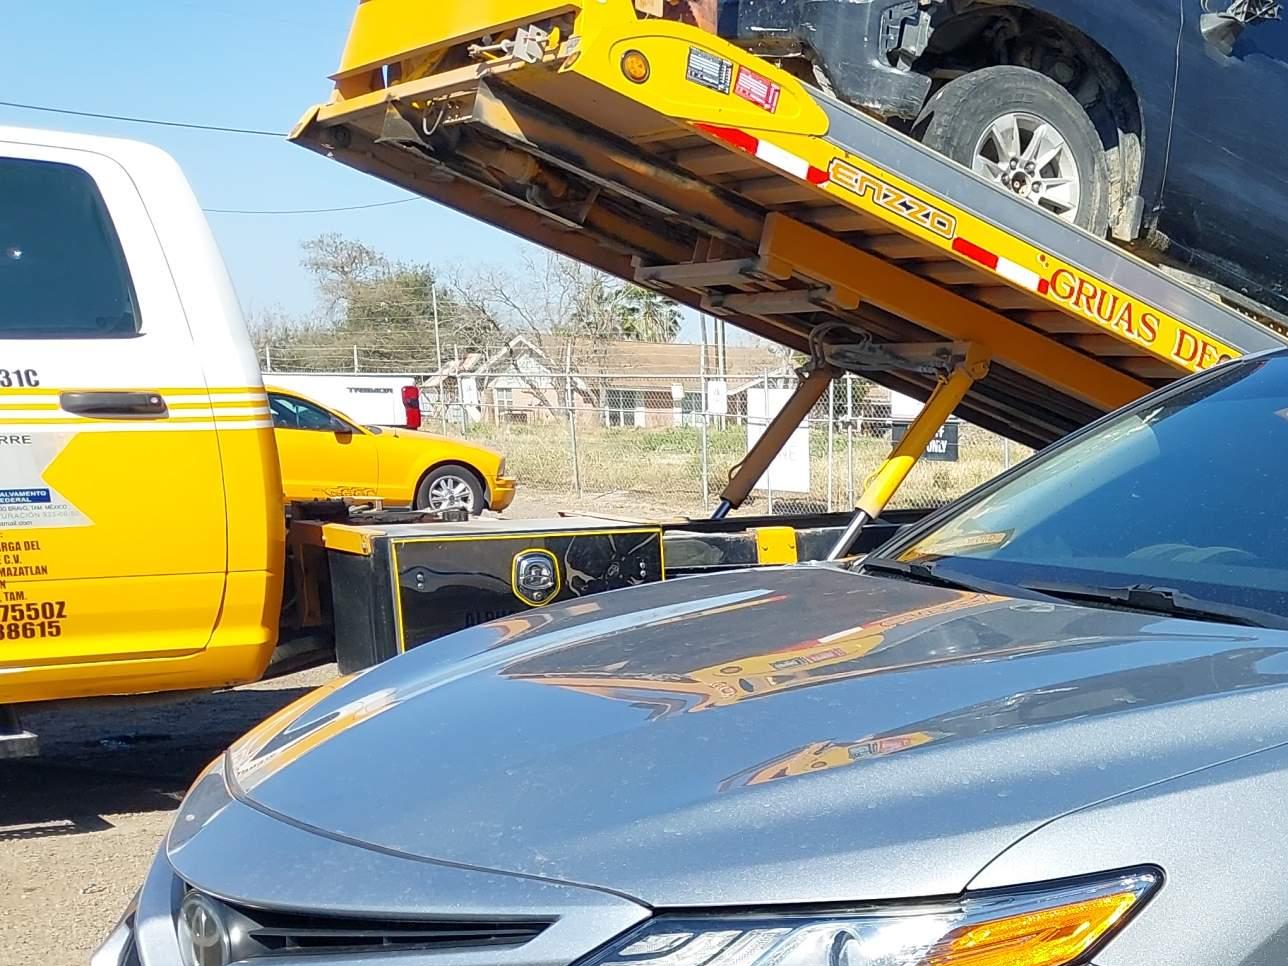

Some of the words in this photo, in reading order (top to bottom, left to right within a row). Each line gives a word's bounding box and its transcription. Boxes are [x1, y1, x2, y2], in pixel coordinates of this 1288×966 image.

[1049, 268, 1161, 343] GRUAS
[24, 541, 40, 551] DEL
[4, 554, 22, 564] C.V.
[4, 590, 27, 602] TAM.
